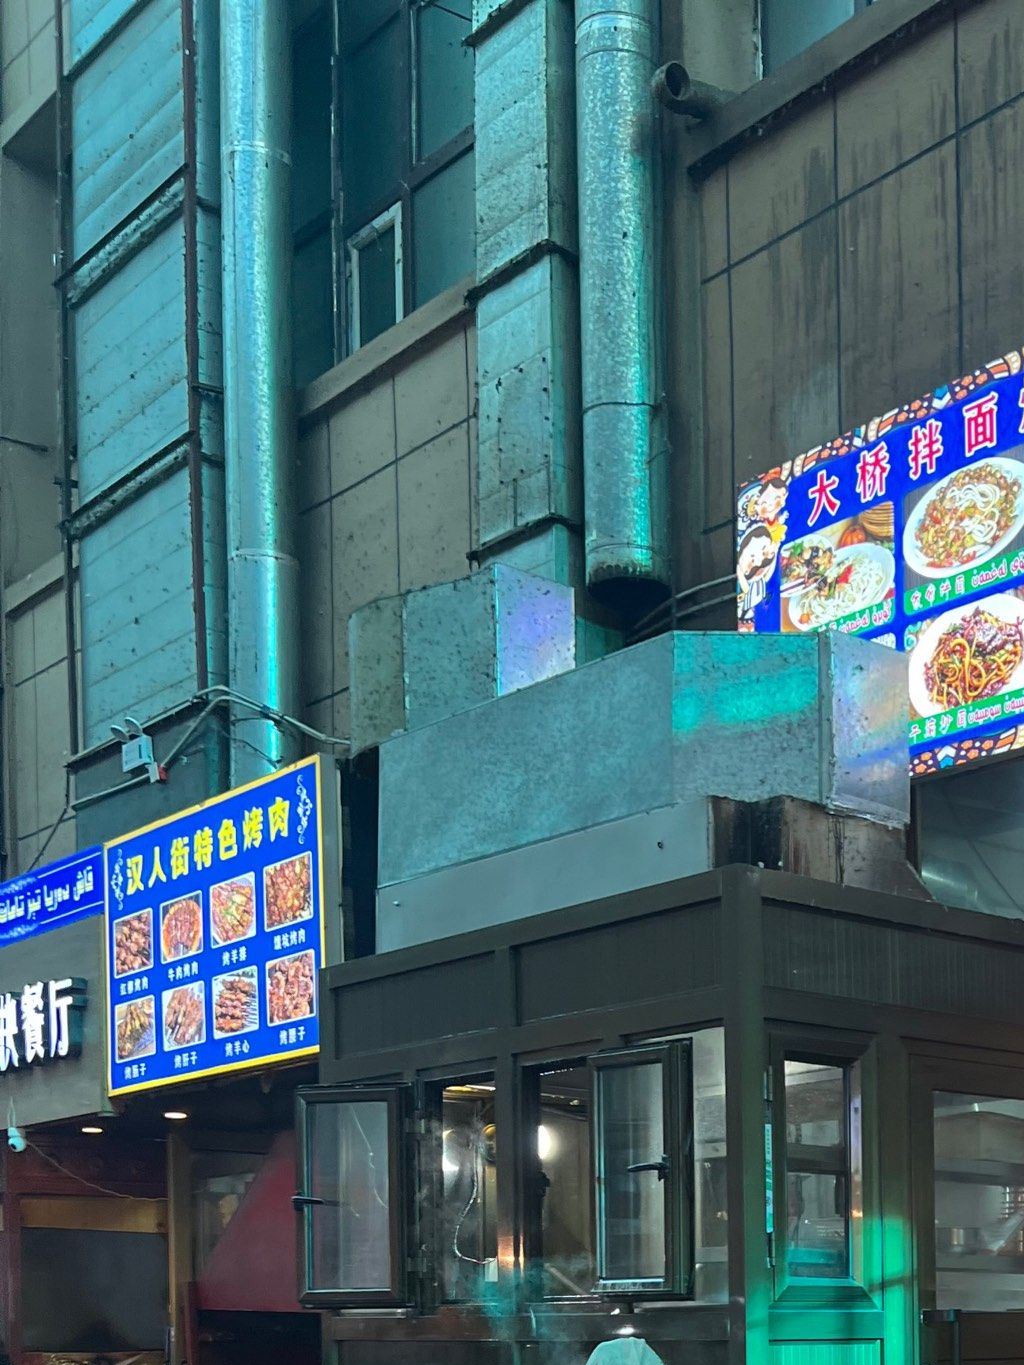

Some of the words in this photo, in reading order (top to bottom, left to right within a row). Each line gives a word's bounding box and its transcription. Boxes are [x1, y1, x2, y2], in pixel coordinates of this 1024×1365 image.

[125, 796, 291, 895] 汉人街特色烤肉
